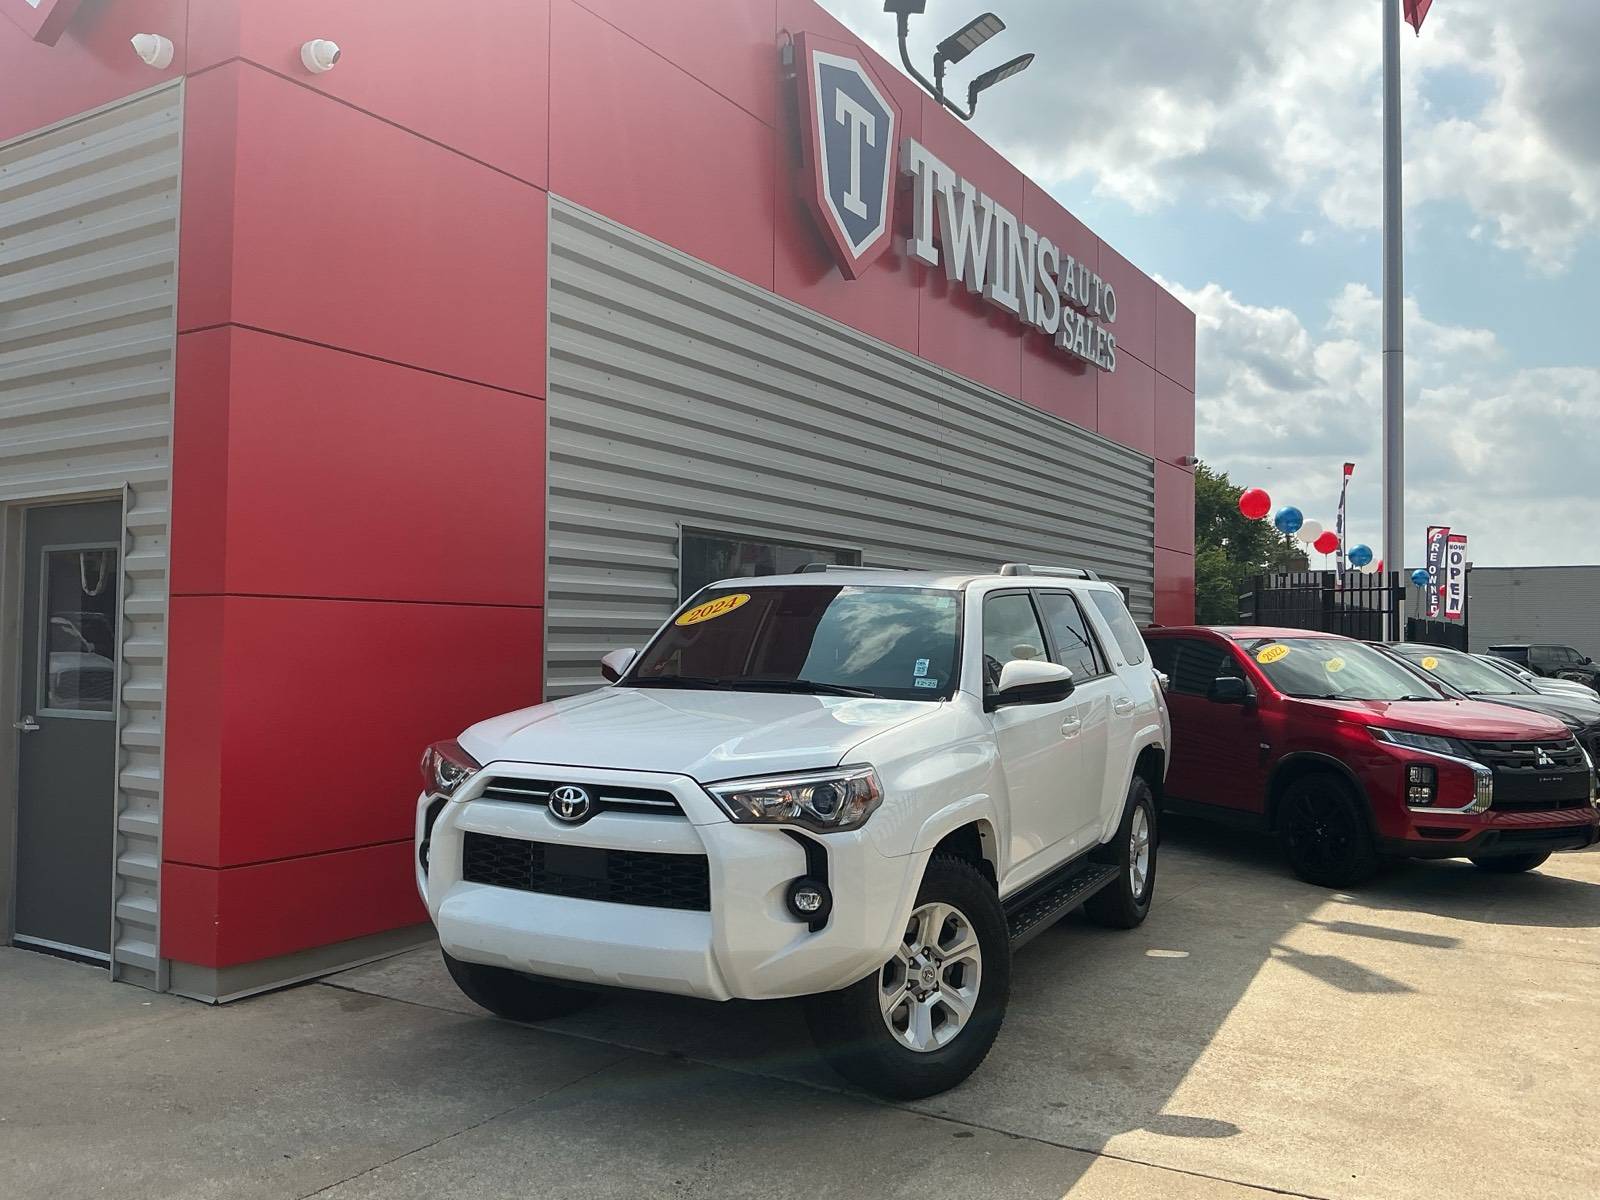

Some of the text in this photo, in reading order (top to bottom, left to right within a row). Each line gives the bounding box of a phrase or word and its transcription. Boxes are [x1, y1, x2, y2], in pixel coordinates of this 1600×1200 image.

[835, 87, 876, 220] T
[903, 137, 1059, 334] TWINS
[1060, 255, 1116, 323] AUTO
[1056, 305, 1116, 373] SALES
[1428, 533, 1442, 614] PRE OWNED
[1450, 552, 1462, 610] OPEN
[688, 597, 738, 622] 2024
[1262, 646, 1286, 661] 2022
